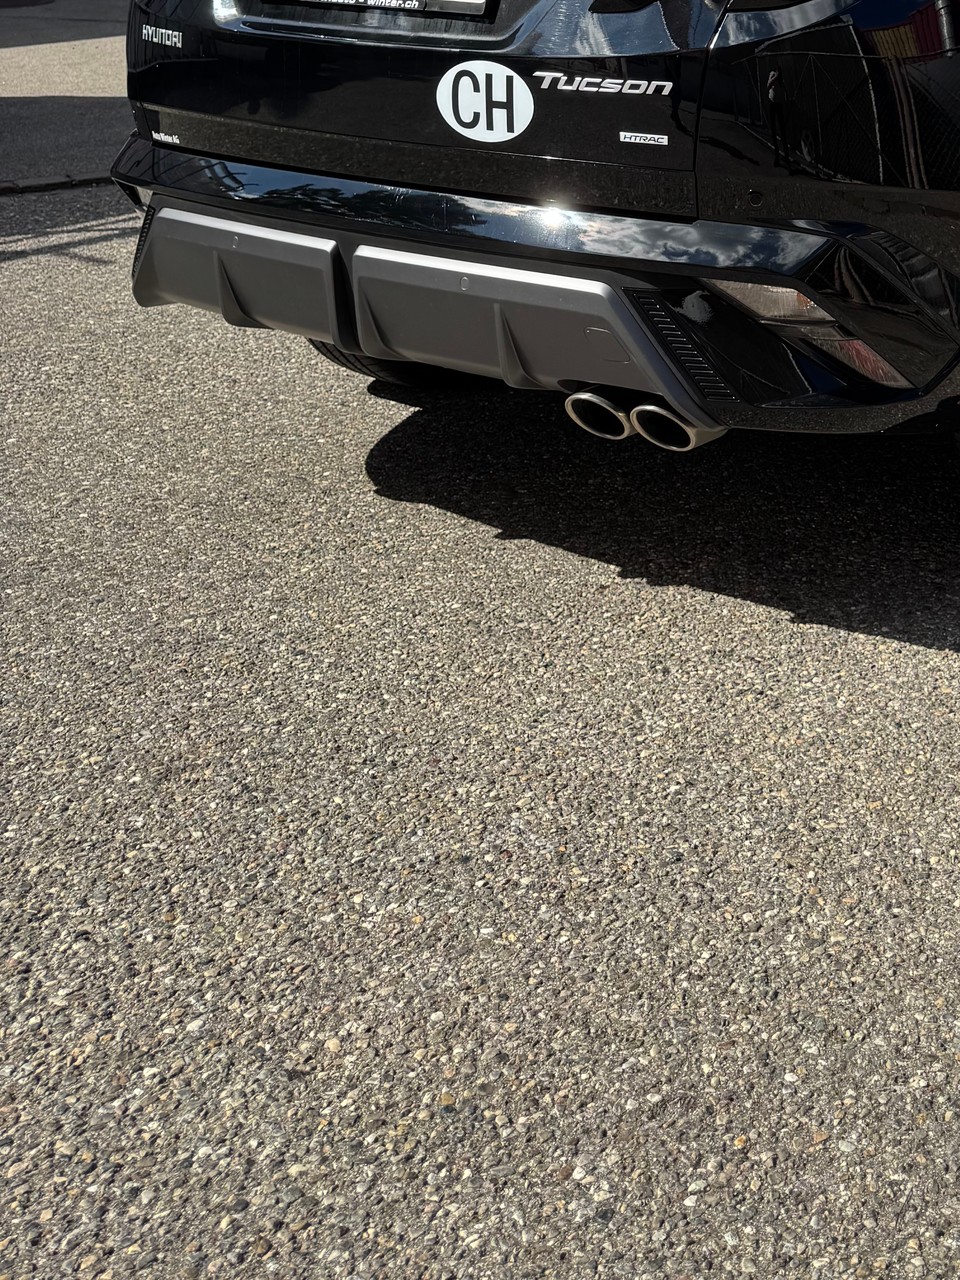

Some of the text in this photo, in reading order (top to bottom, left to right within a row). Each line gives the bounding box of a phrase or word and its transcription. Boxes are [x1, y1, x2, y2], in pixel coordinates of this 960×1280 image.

[142, 24, 183, 49] HYUNDAI
[451, 69, 515, 134] CH
[622, 133, 666, 144] HTRAC
